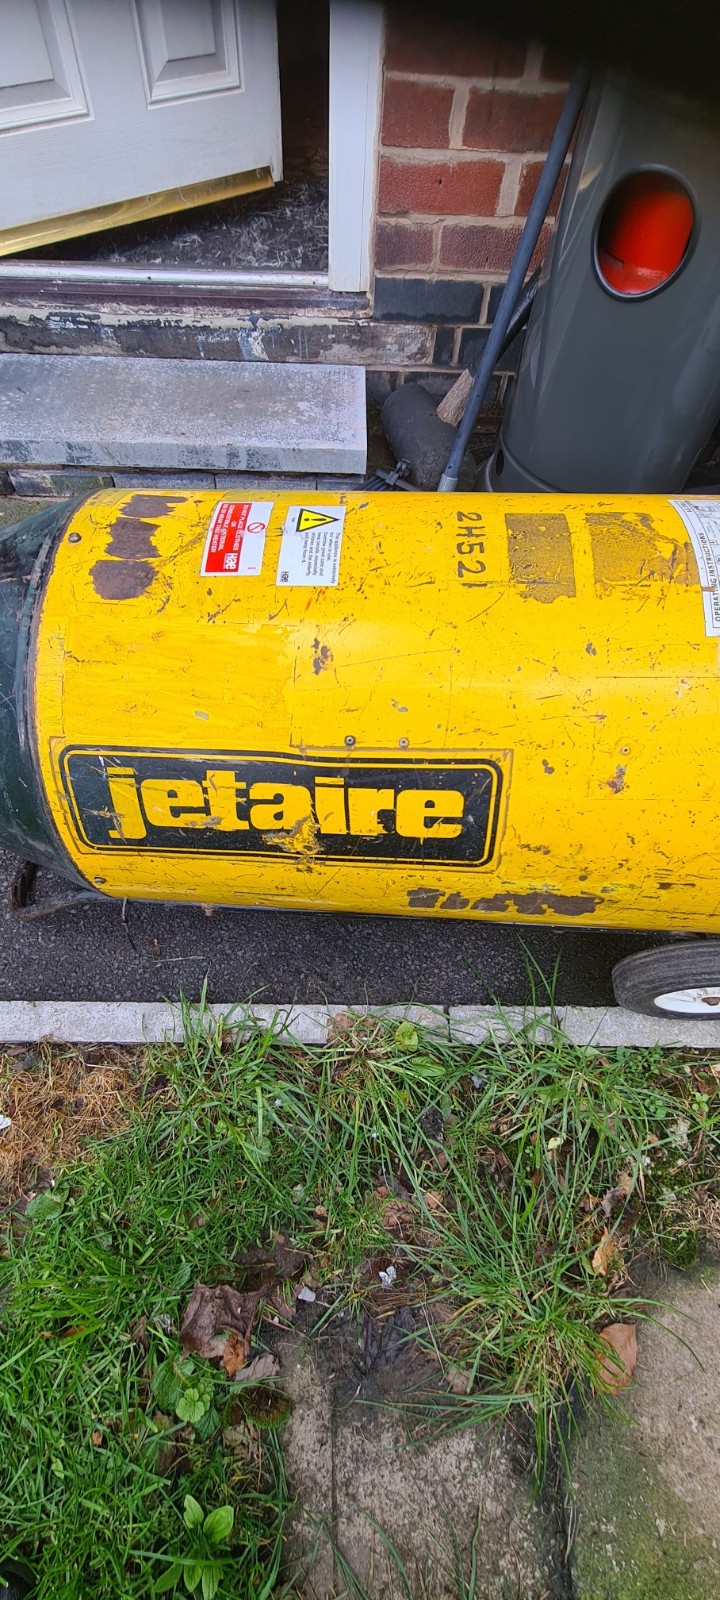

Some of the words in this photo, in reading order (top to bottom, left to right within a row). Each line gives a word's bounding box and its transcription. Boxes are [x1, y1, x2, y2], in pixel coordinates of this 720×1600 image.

[237, 517, 245, 529] PLACE
[211, 534, 219, 552] HEATER
[233, 530, 242, 550] CLOTHES
[699, 532, 715, 577] INSTRUCTIONS
[711, 578, 720, 622] OPERATNG
[107, 766, 465, 840] jetaire
